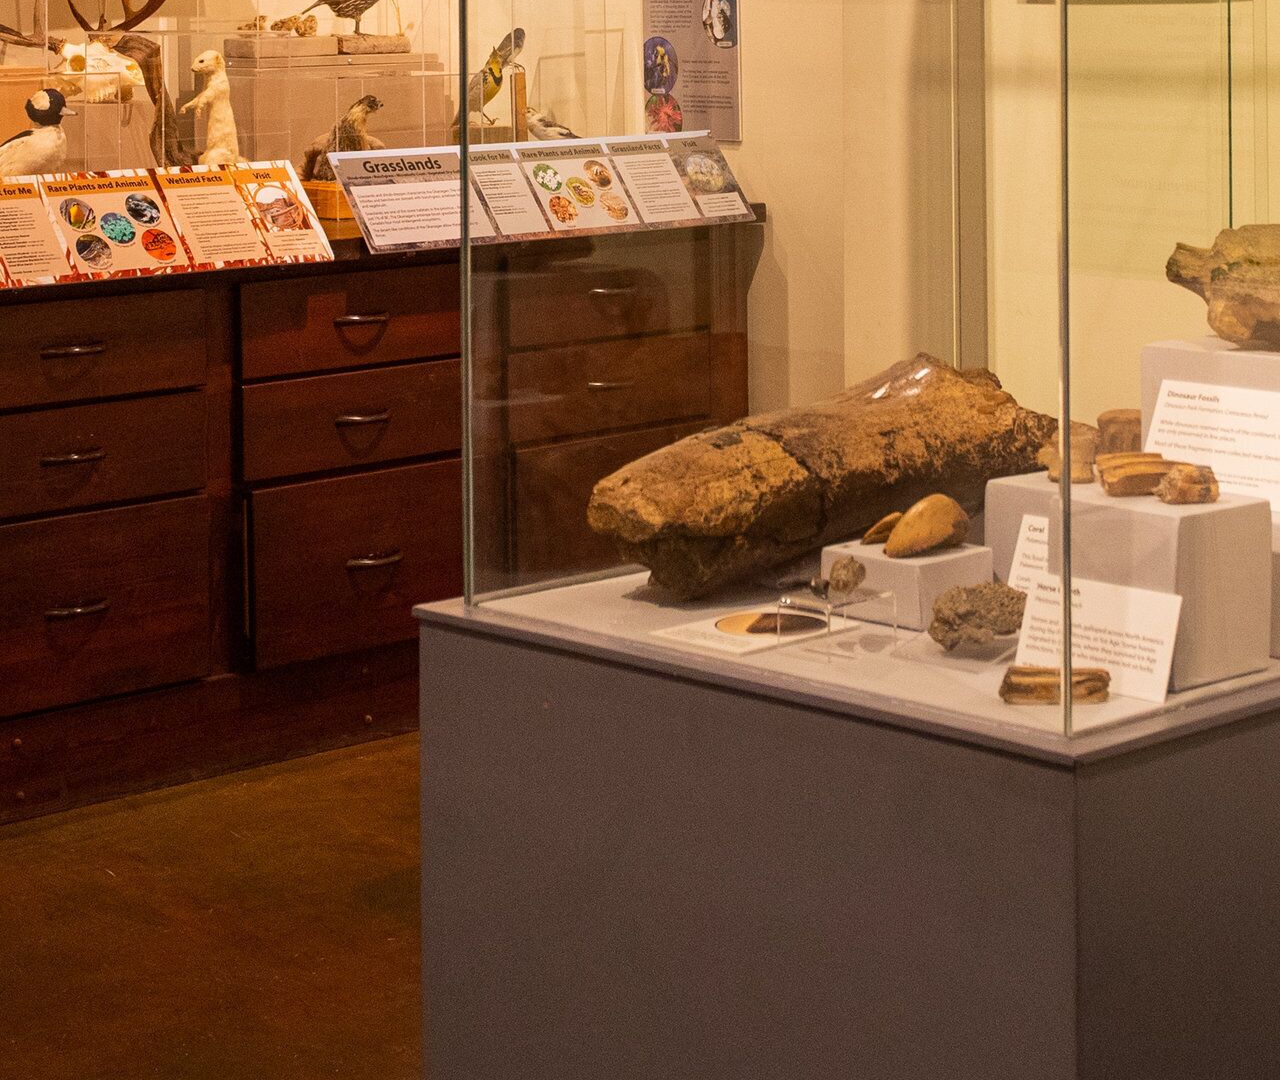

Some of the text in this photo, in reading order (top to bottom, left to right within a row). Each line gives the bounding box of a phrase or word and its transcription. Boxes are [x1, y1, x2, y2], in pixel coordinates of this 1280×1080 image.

[521, 151, 538, 159] Rare
[539, 150, 559, 158] Plants
[574, 147, 600, 155] Animals
[362, 157, 442, 173] Grasslands
[166, 175, 223, 185] Wetland Facts
[252, 172, 271, 180] Visit
[3, 187, 17, 195] for
[19, 187, 32, 195] Me
[47, 179, 149, 193] Rare Plants and Animals
